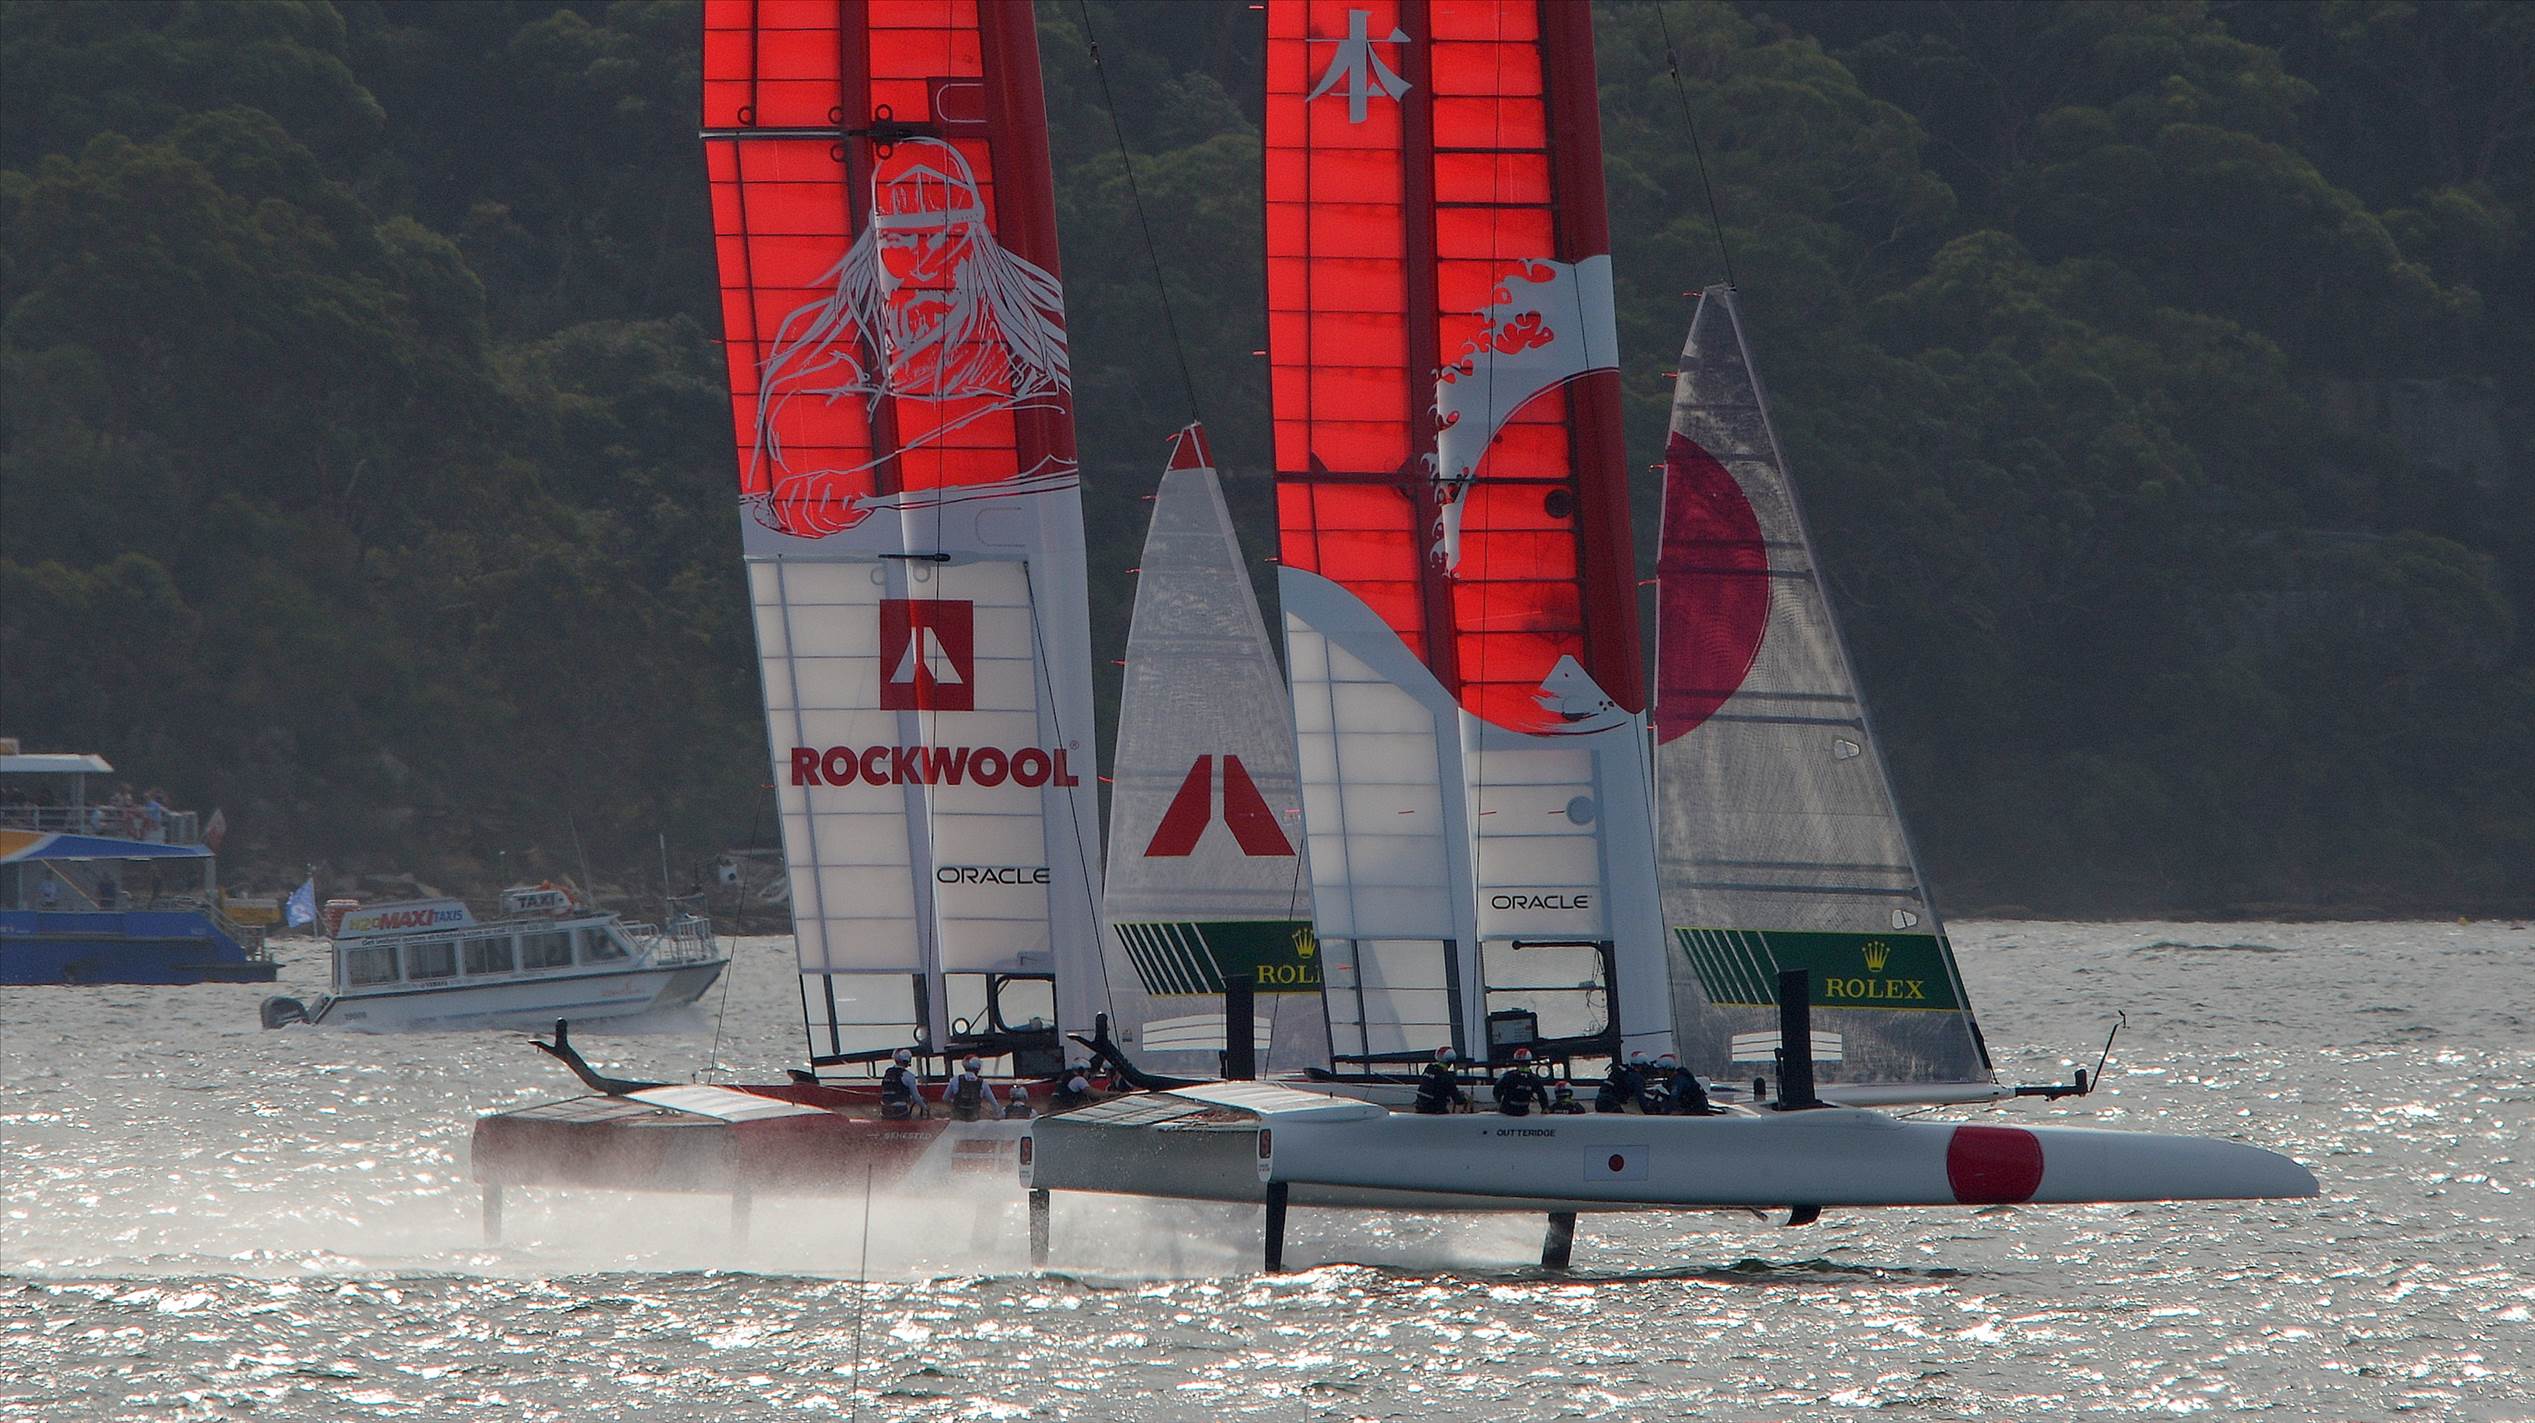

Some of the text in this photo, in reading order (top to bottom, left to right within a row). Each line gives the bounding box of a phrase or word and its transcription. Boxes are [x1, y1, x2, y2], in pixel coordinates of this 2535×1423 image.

[1304, 8, 1413, 124] 本
[790, 745, 1080, 788] ROCKWOOL
[936, 866, 1051, 885] ORACLE
[518, 893, 556, 908] TAXI
[1491, 895, 1589, 910] ORACLE
[1825, 977, 1926, 1000] ROLEX
[1496, 1128, 1557, 1138] OUTTERIDGE
